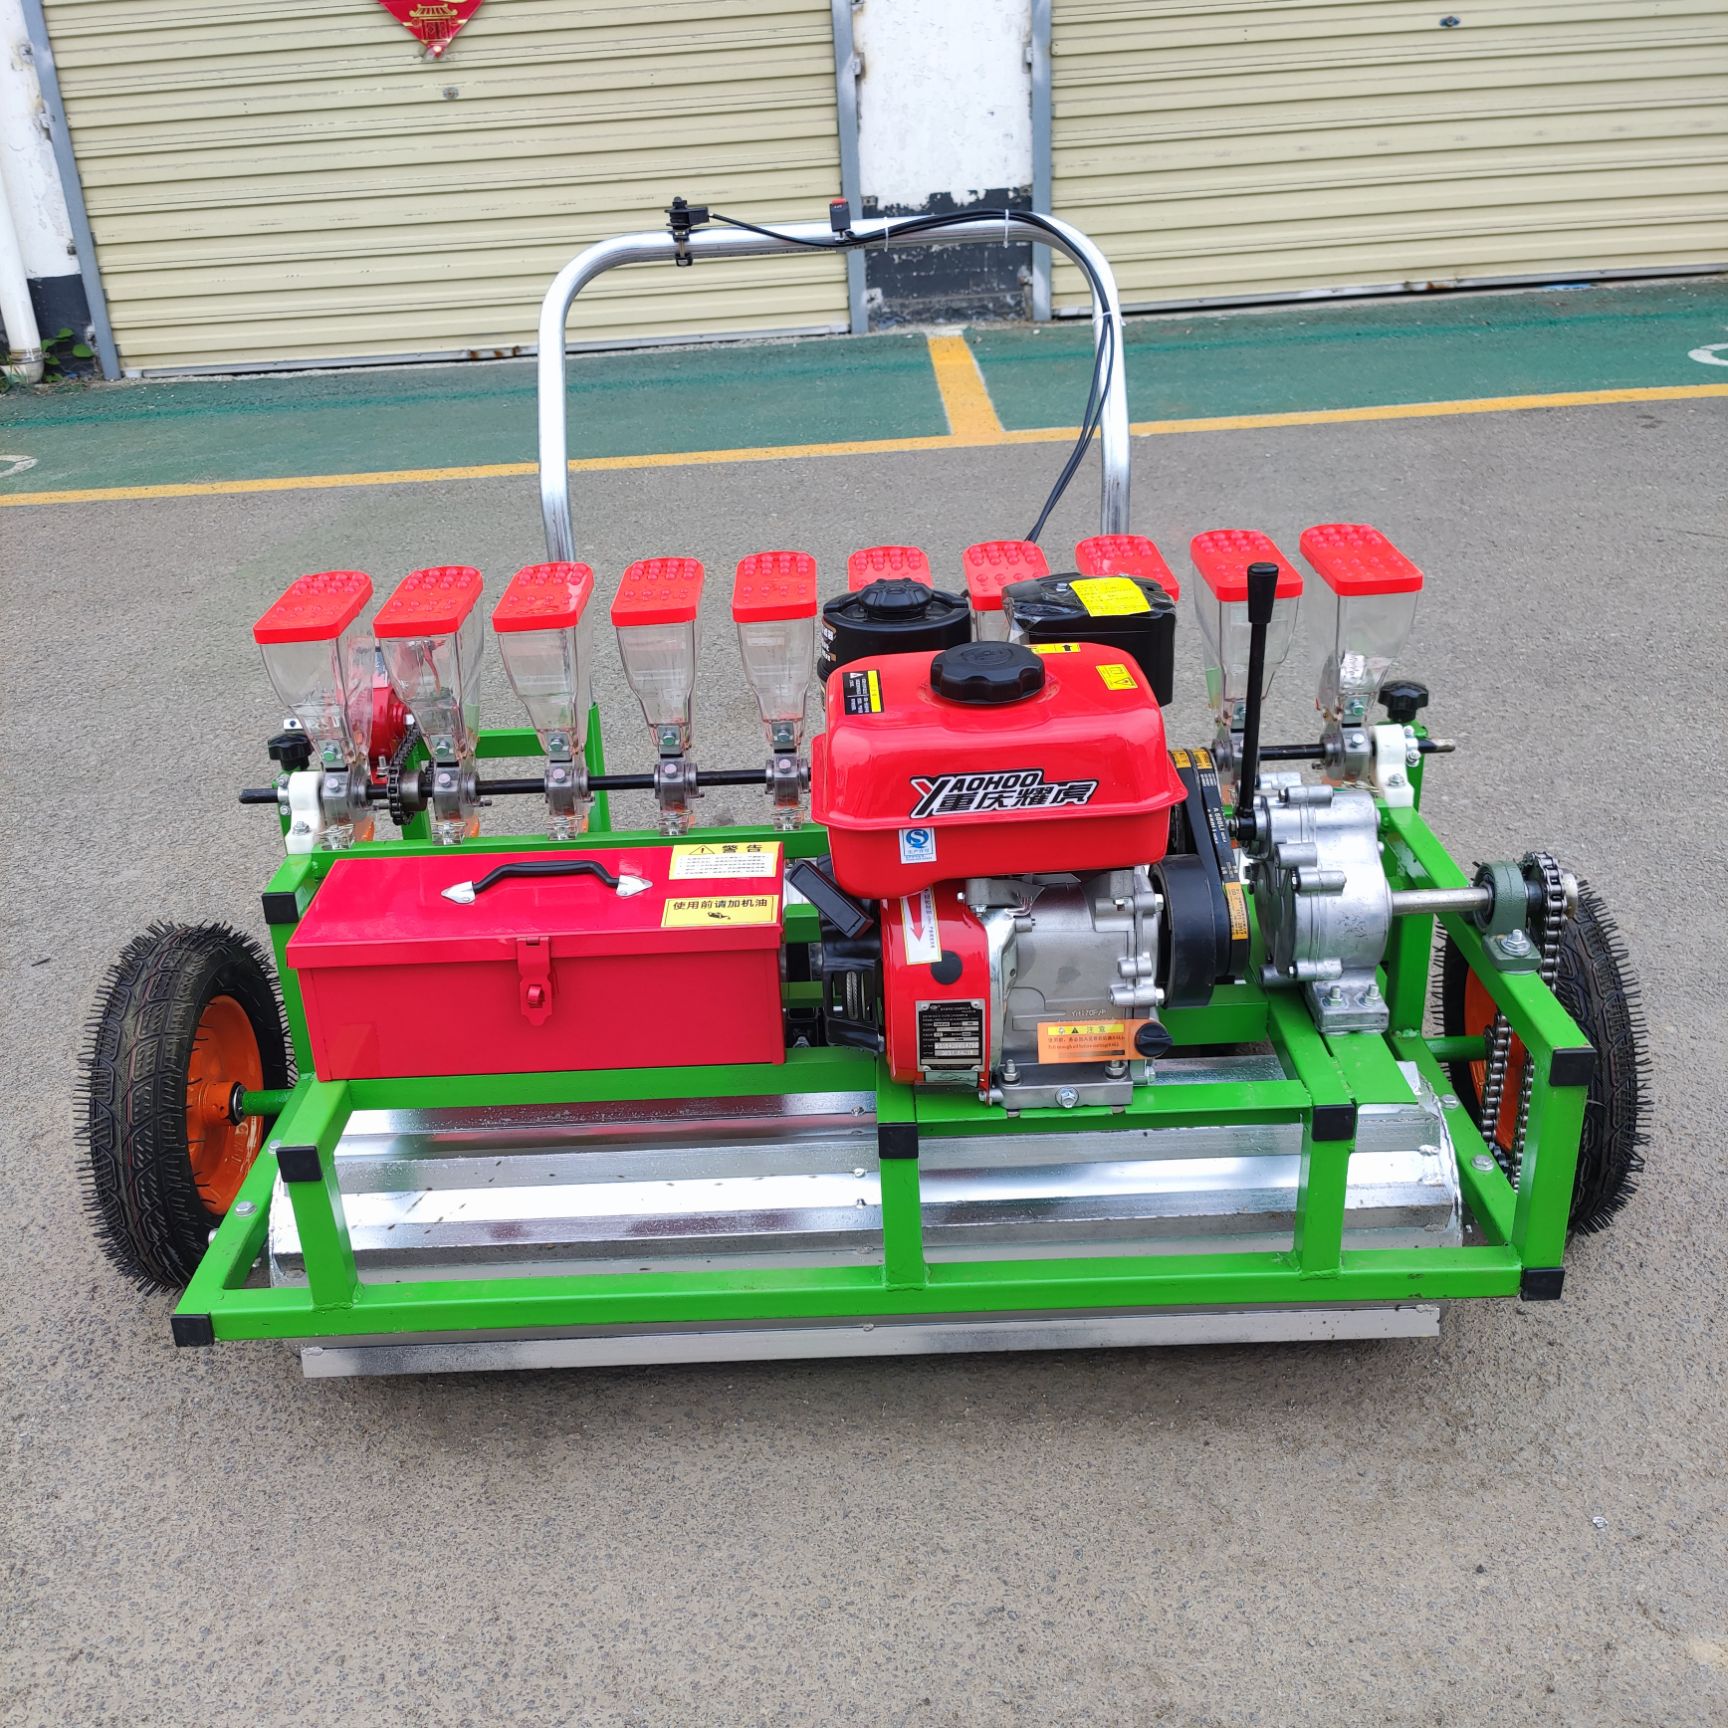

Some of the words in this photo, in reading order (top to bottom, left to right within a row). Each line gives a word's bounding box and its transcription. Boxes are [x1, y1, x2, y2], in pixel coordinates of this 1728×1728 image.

[911, 773, 1038, 816] YAOHOO
[936, 782, 1093, 812] 重庆耀虎
[722, 844, 762, 853] 警告
[673, 899, 767, 910] 使用前请加机油
